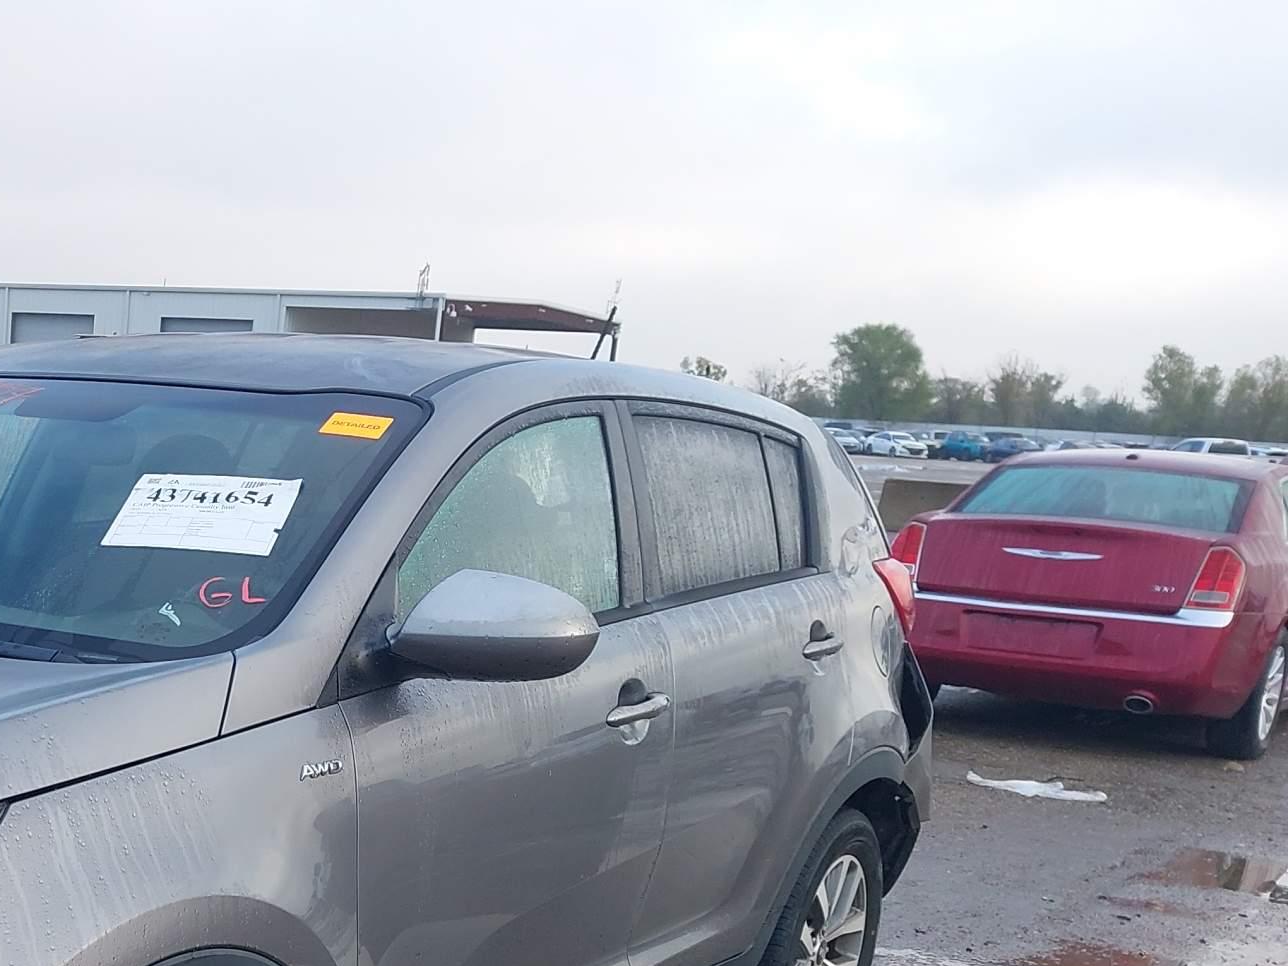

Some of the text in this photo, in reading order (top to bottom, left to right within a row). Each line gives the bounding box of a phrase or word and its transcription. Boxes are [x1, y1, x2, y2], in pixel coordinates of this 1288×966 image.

[331, 420, 381, 430] DETAILED
[146, 487, 274, 508] 43741654
[299, 759, 343, 781] AWD
